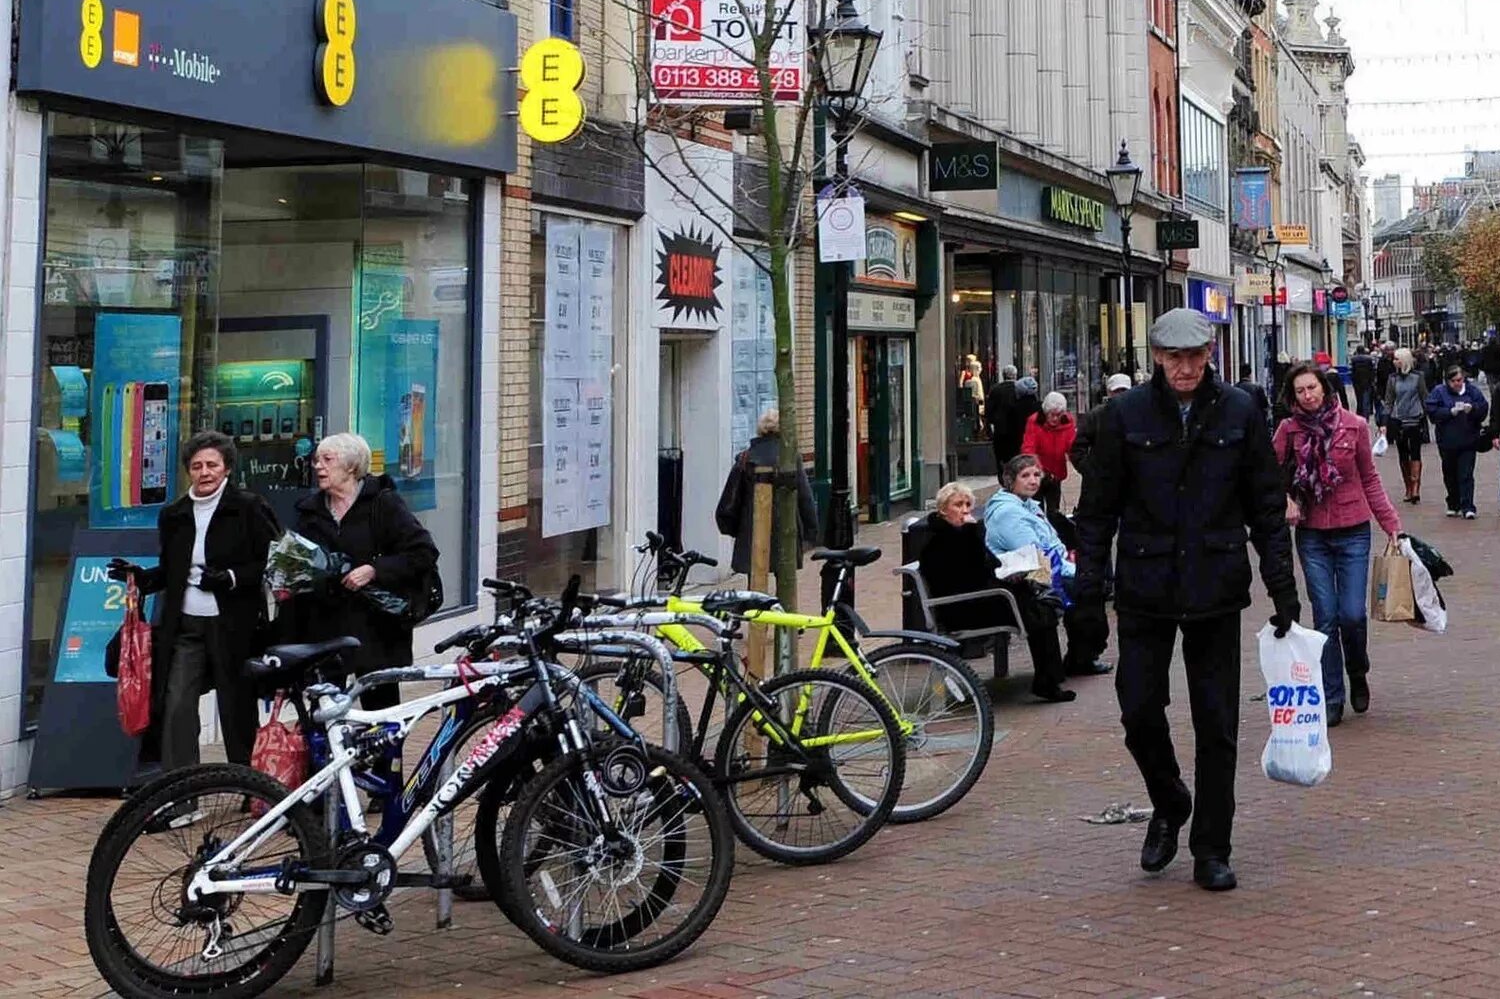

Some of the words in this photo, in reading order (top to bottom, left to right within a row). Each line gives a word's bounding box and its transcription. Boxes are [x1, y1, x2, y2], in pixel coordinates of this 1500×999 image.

[659, 68, 700, 85] 0113
[705, 70, 742, 86] 388
[747, 70, 795, 87] 448
[934, 154, 990, 179] M&S
